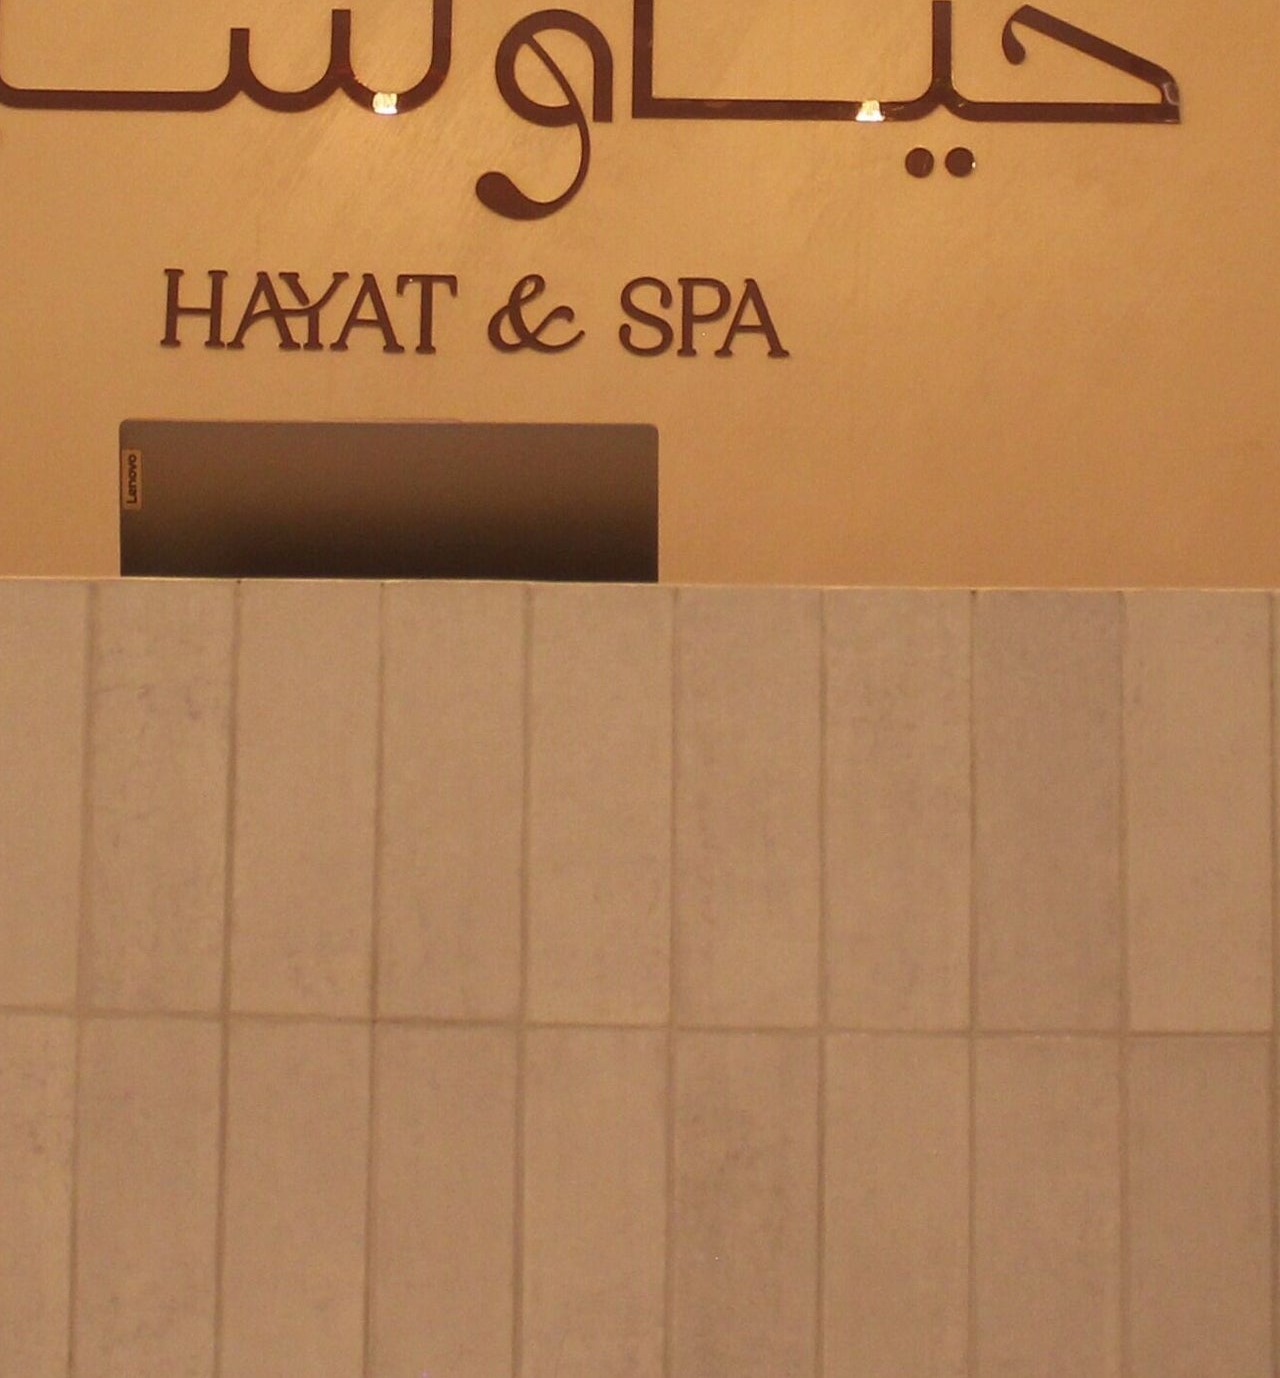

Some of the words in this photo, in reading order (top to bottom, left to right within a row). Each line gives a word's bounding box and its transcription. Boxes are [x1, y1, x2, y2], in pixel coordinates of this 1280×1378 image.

[160, 269, 458, 355] HAYAT
[488, 274, 586, 355] &
[619, 277, 790, 359] SPA
[126, 454, 138, 504] Lenovo
